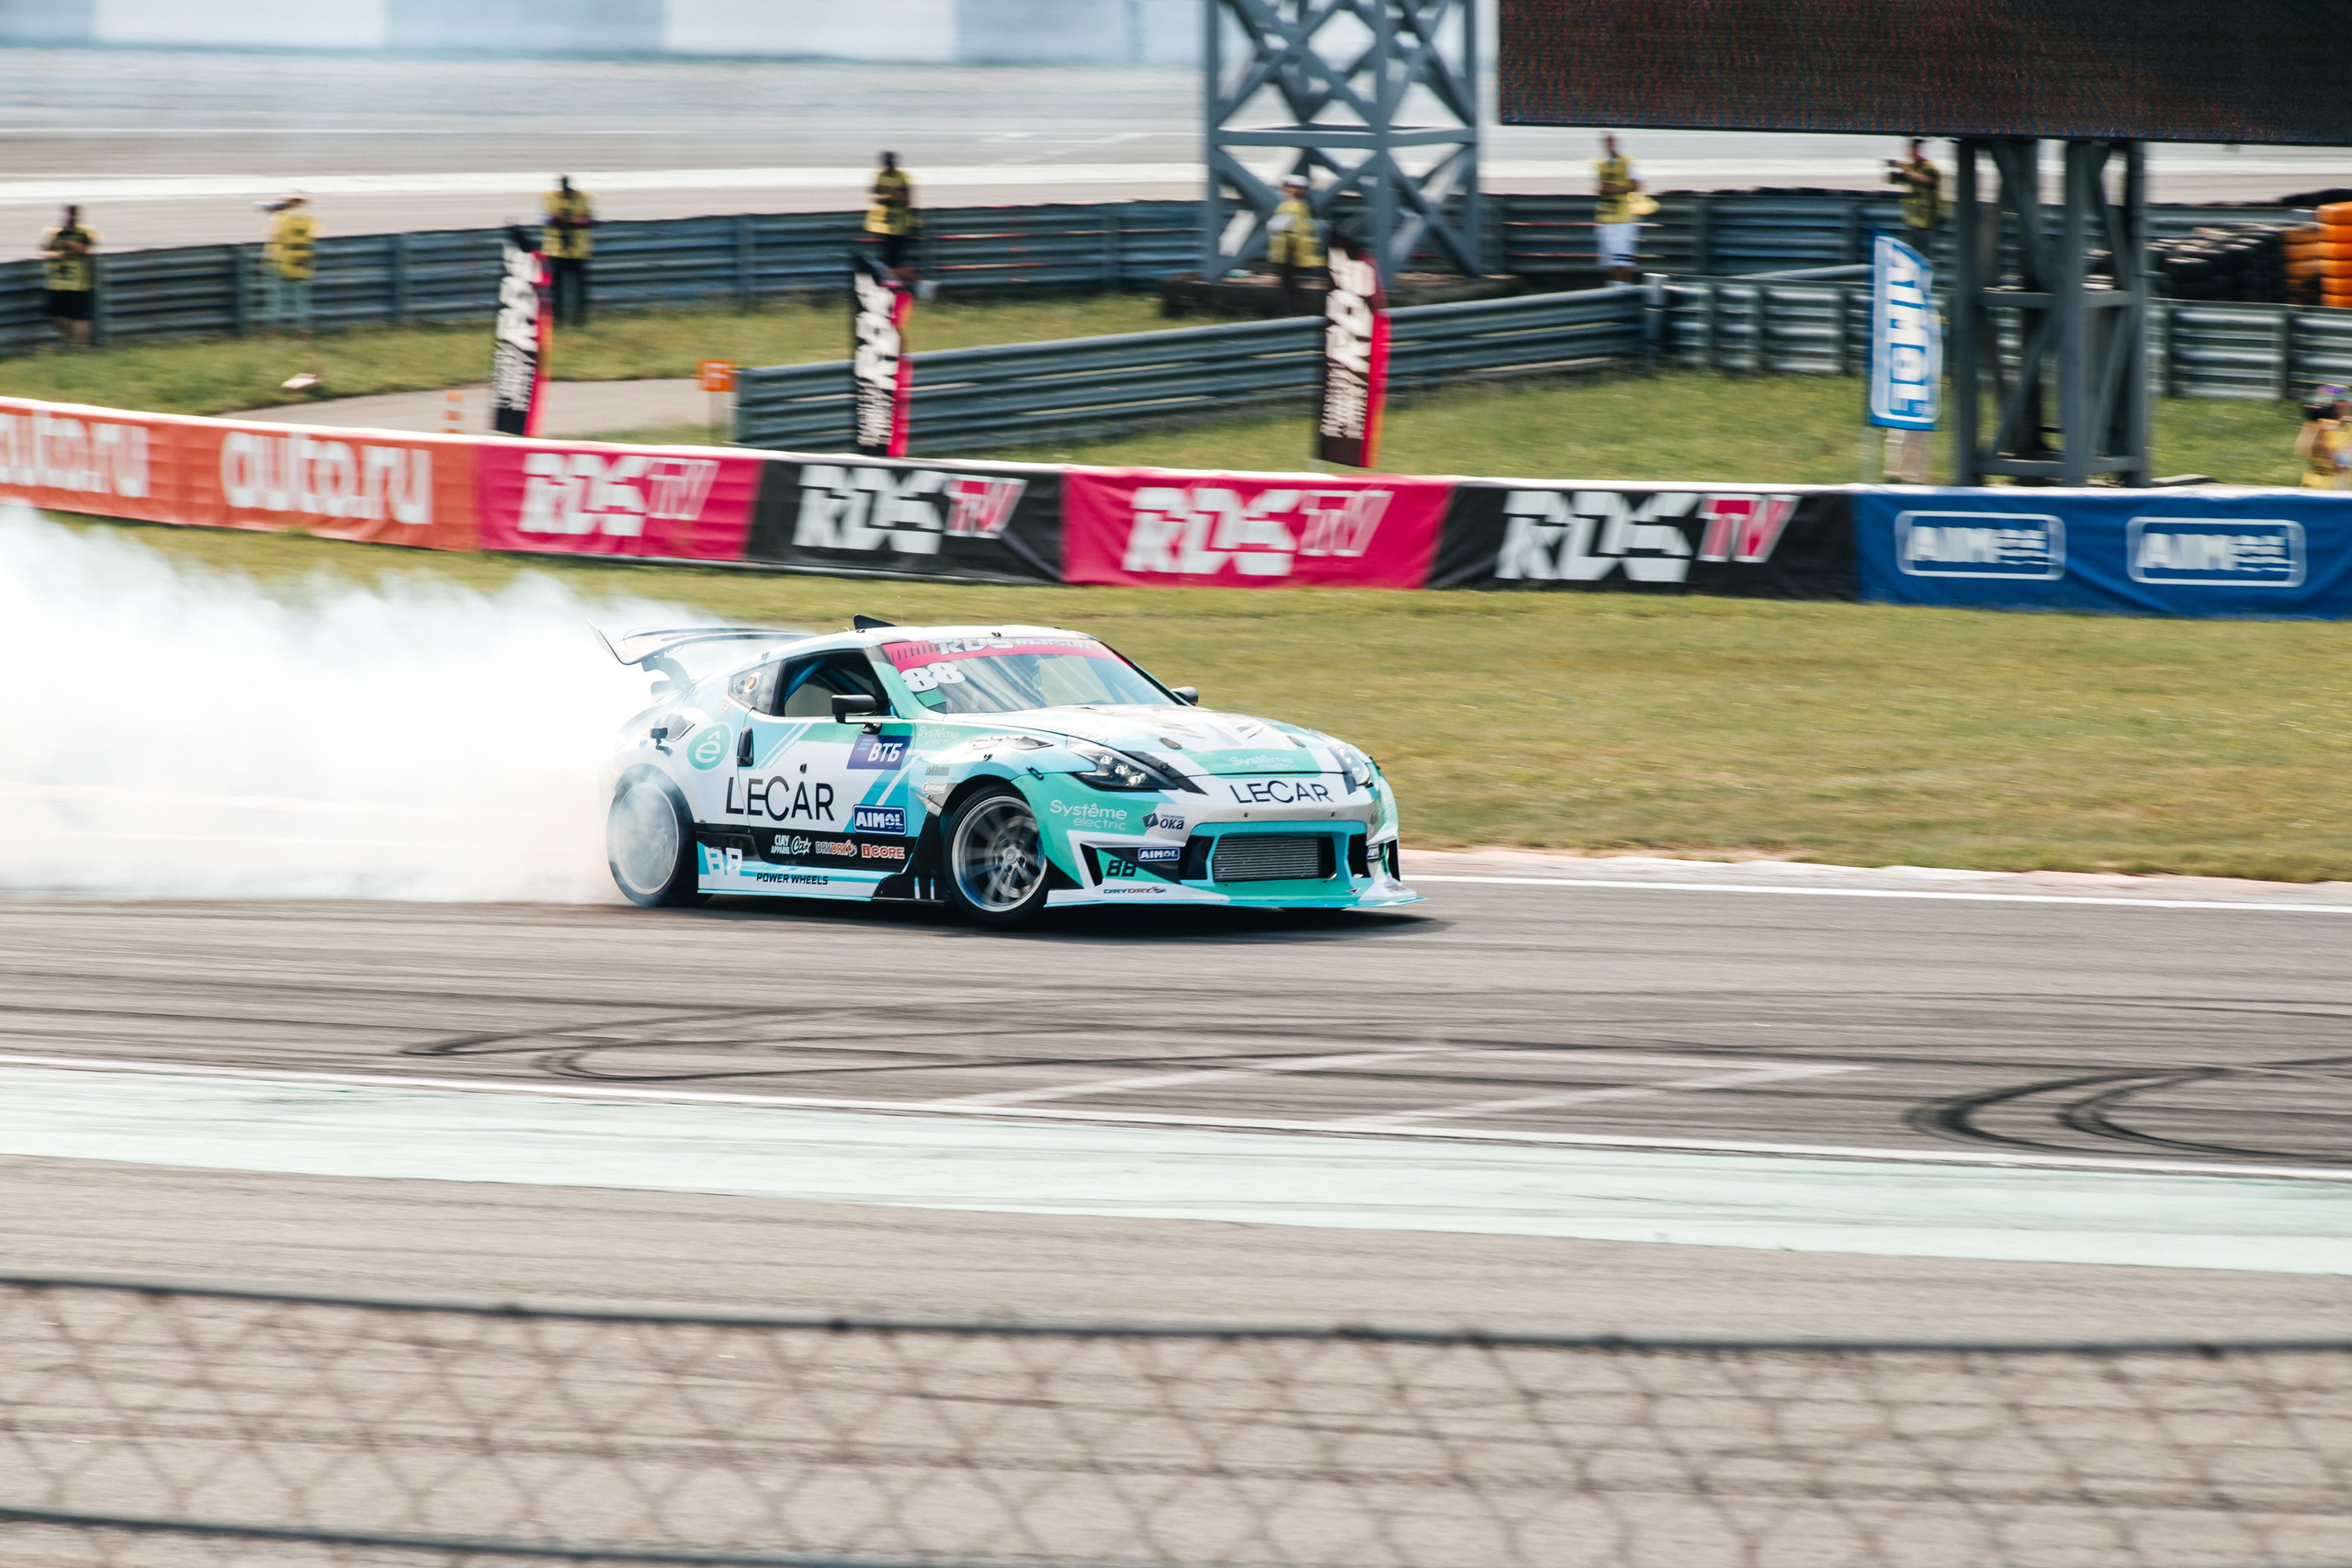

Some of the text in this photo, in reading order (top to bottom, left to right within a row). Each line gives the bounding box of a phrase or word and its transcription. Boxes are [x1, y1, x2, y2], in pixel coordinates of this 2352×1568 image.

[220, 431, 433, 525] auto.ru
[518, 453, 649, 536] RDS
[793, 465, 947, 555] RDS
[1122, 487, 1306, 577] RDS
[1496, 491, 1800, 582] RDS TV
[899, 661, 967, 694] 88
[867, 742, 904, 762] ВТБ
[725, 775, 835, 821] LECAR
[1229, 780, 1334, 804] LECAR
[855, 811, 904, 829] AIMOL
[1049, 799, 1127, 821] Système
[1073, 817, 1127, 831] electric
[771, 845, 790, 854] APPAREL
[1140, 850, 1178, 859] AIMOL
[756, 872, 829, 886] POWER WHEELS
